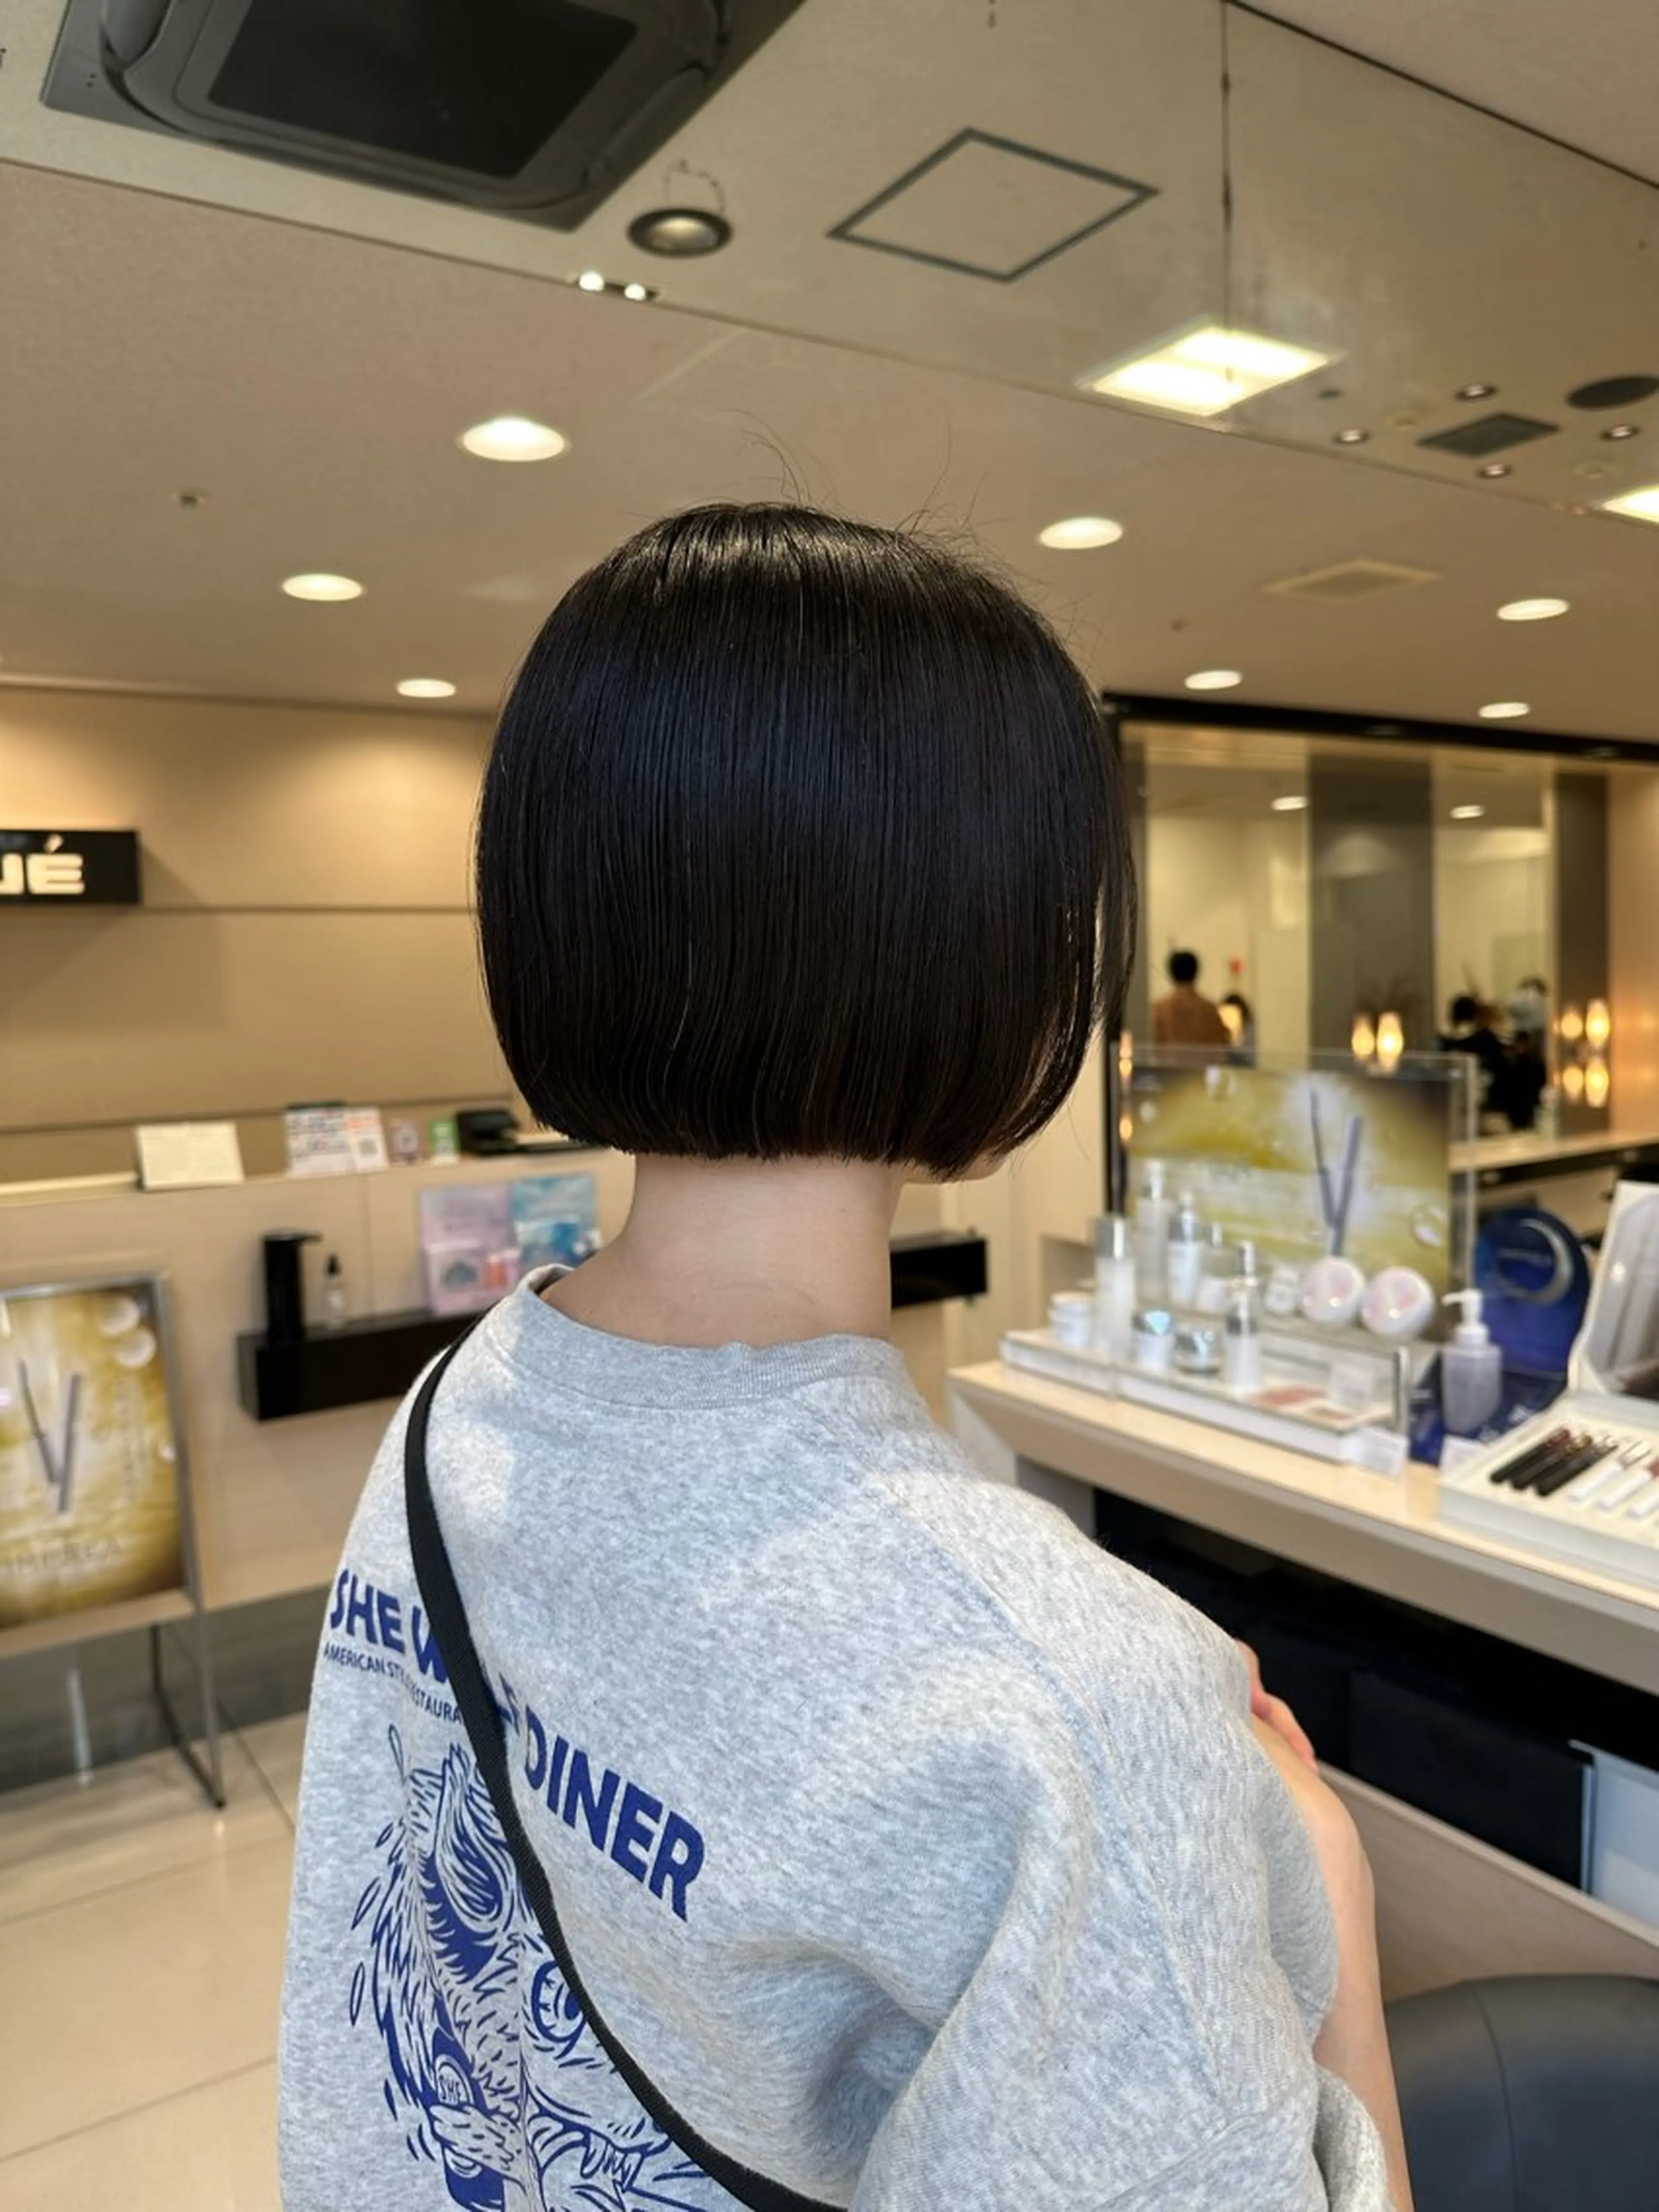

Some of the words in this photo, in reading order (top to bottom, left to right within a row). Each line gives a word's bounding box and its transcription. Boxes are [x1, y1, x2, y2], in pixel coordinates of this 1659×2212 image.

[324, 1643, 386, 1675] AMERICAN
[330, 1568, 405, 1654] SHE
[524, 1705, 704, 1922] DINER
